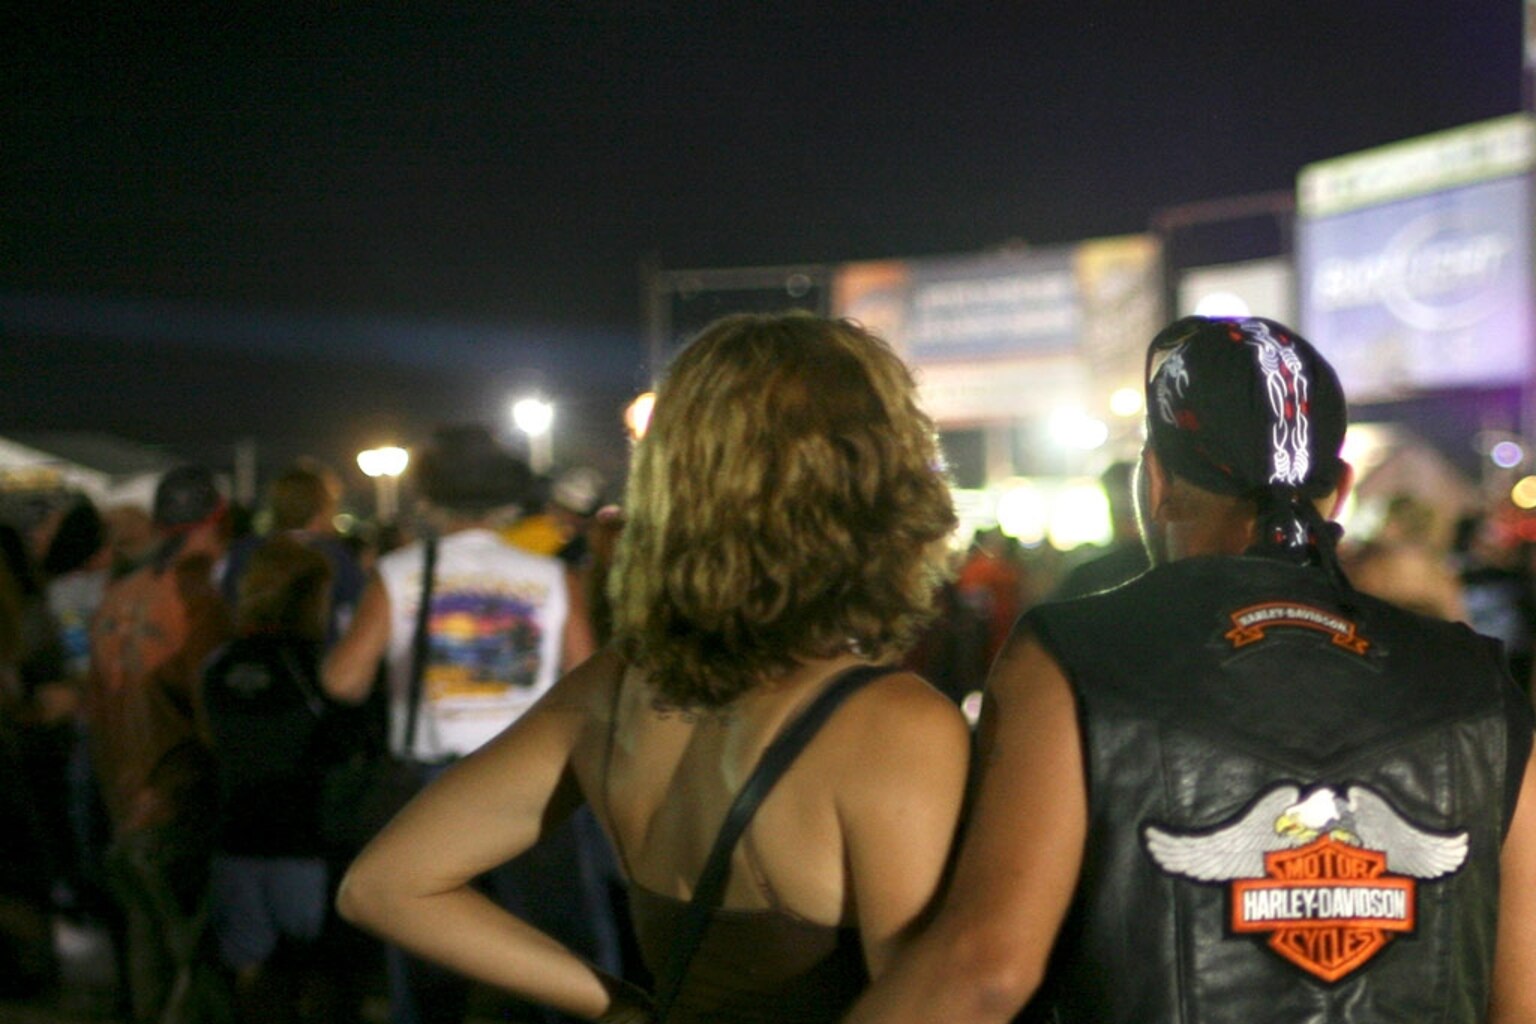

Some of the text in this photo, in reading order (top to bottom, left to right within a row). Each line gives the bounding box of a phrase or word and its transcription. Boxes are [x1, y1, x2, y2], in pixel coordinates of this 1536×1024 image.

[1239, 607, 1349, 635] HARLEY-DAVIDSON
[1283, 851, 1369, 880] MOTOR
[1243, 886, 1407, 922] HARLEY-DAVIDSON
[1288, 928, 1373, 965] CYCLES
